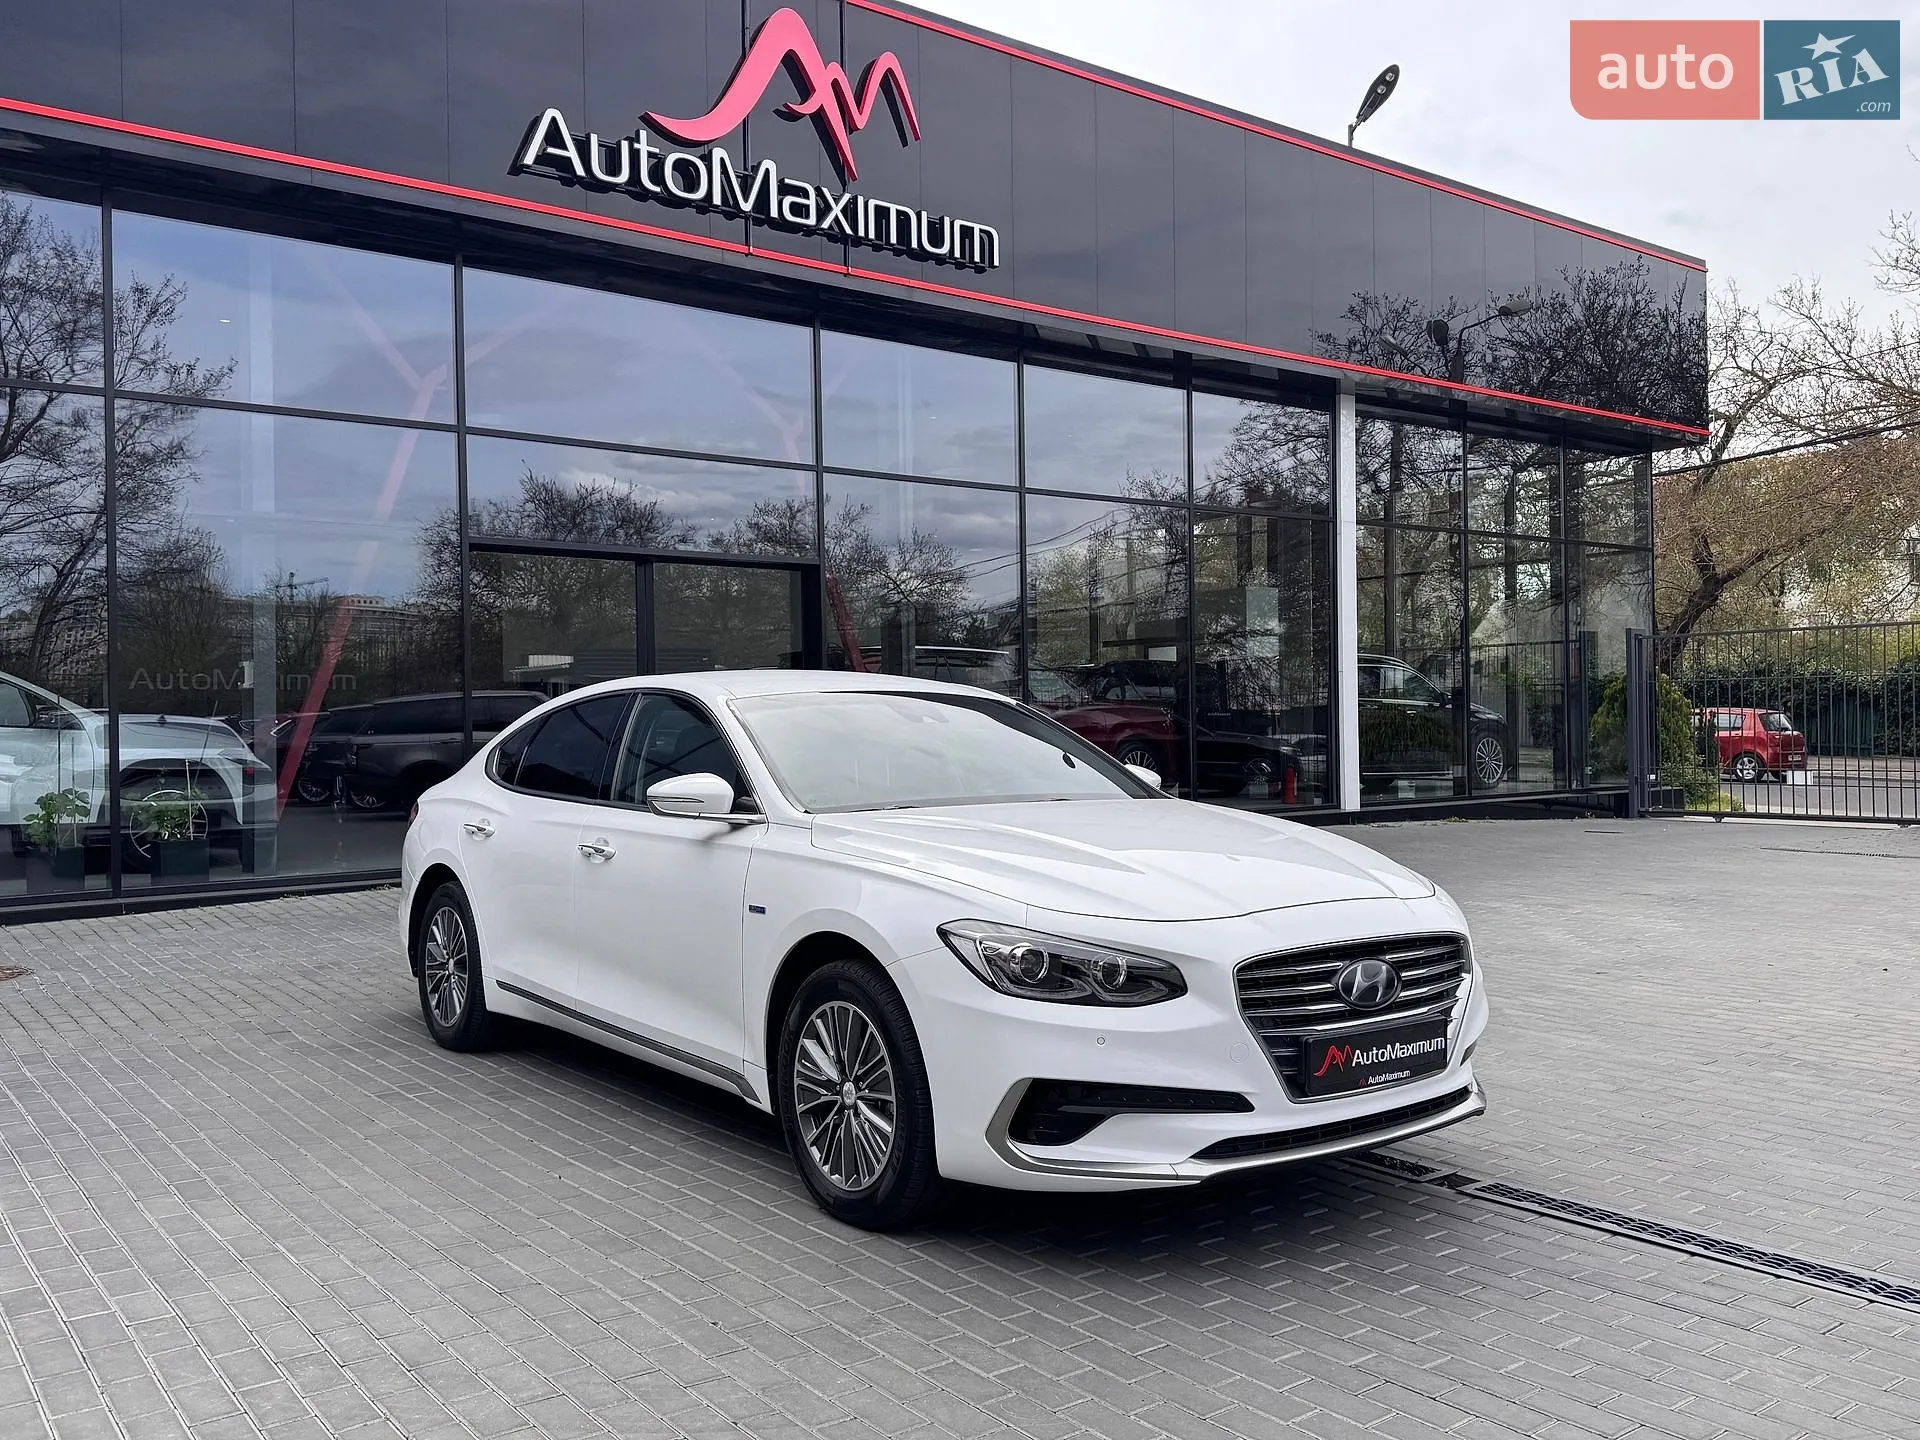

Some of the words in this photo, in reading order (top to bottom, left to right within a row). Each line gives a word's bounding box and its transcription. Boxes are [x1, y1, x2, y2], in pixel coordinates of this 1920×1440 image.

[521, 107, 1000, 269] AutoMaximum
[1351, 1036, 1446, 1067] AutoMaximum
[1368, 1069, 1411, 1085] AutoMaximum
